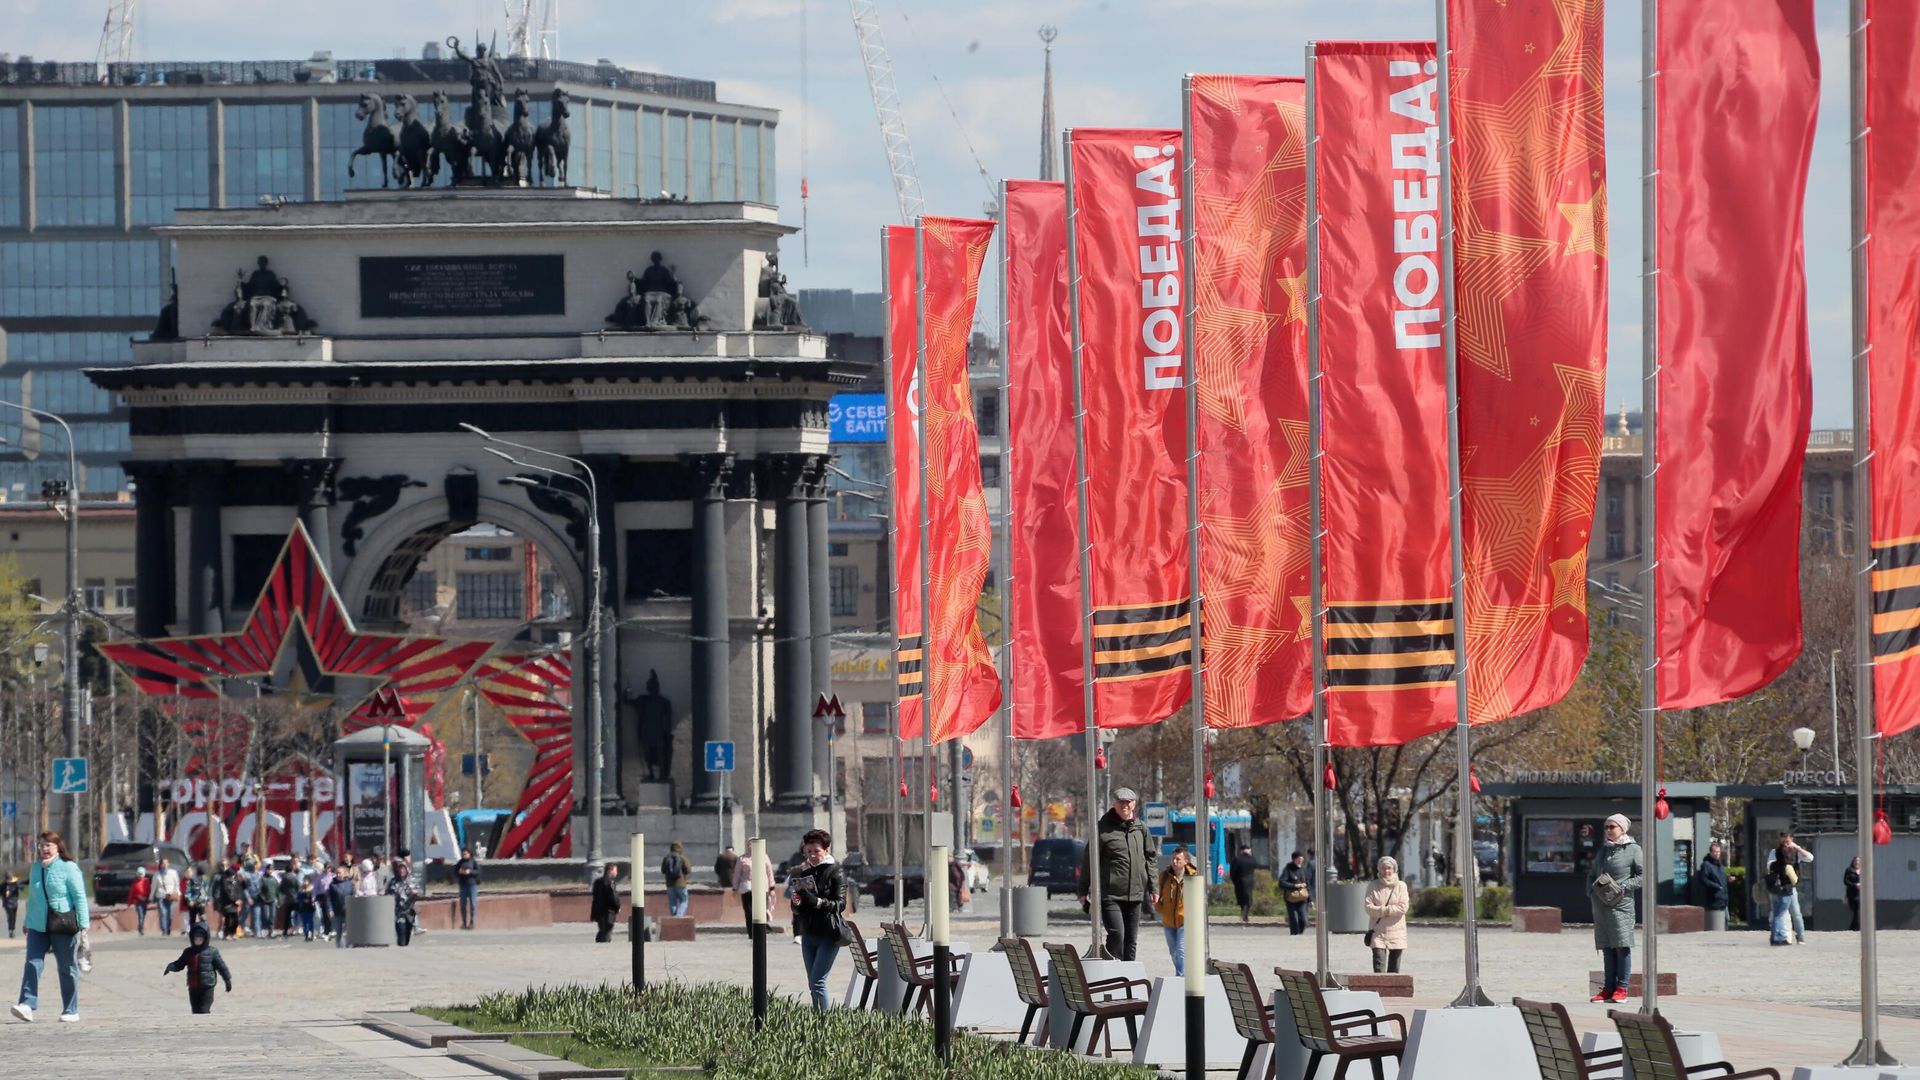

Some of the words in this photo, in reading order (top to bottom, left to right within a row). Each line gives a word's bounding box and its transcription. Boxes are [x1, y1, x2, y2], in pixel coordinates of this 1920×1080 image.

[1390, 60, 1441, 349] ПОБЕДА!
[1133, 145, 1184, 391] ПОБЕДА!
[845, 420, 886, 433] ЕАПТ
[1783, 770, 1847, 784] ПРЕССА
[105, 811, 461, 865] МОСКА
